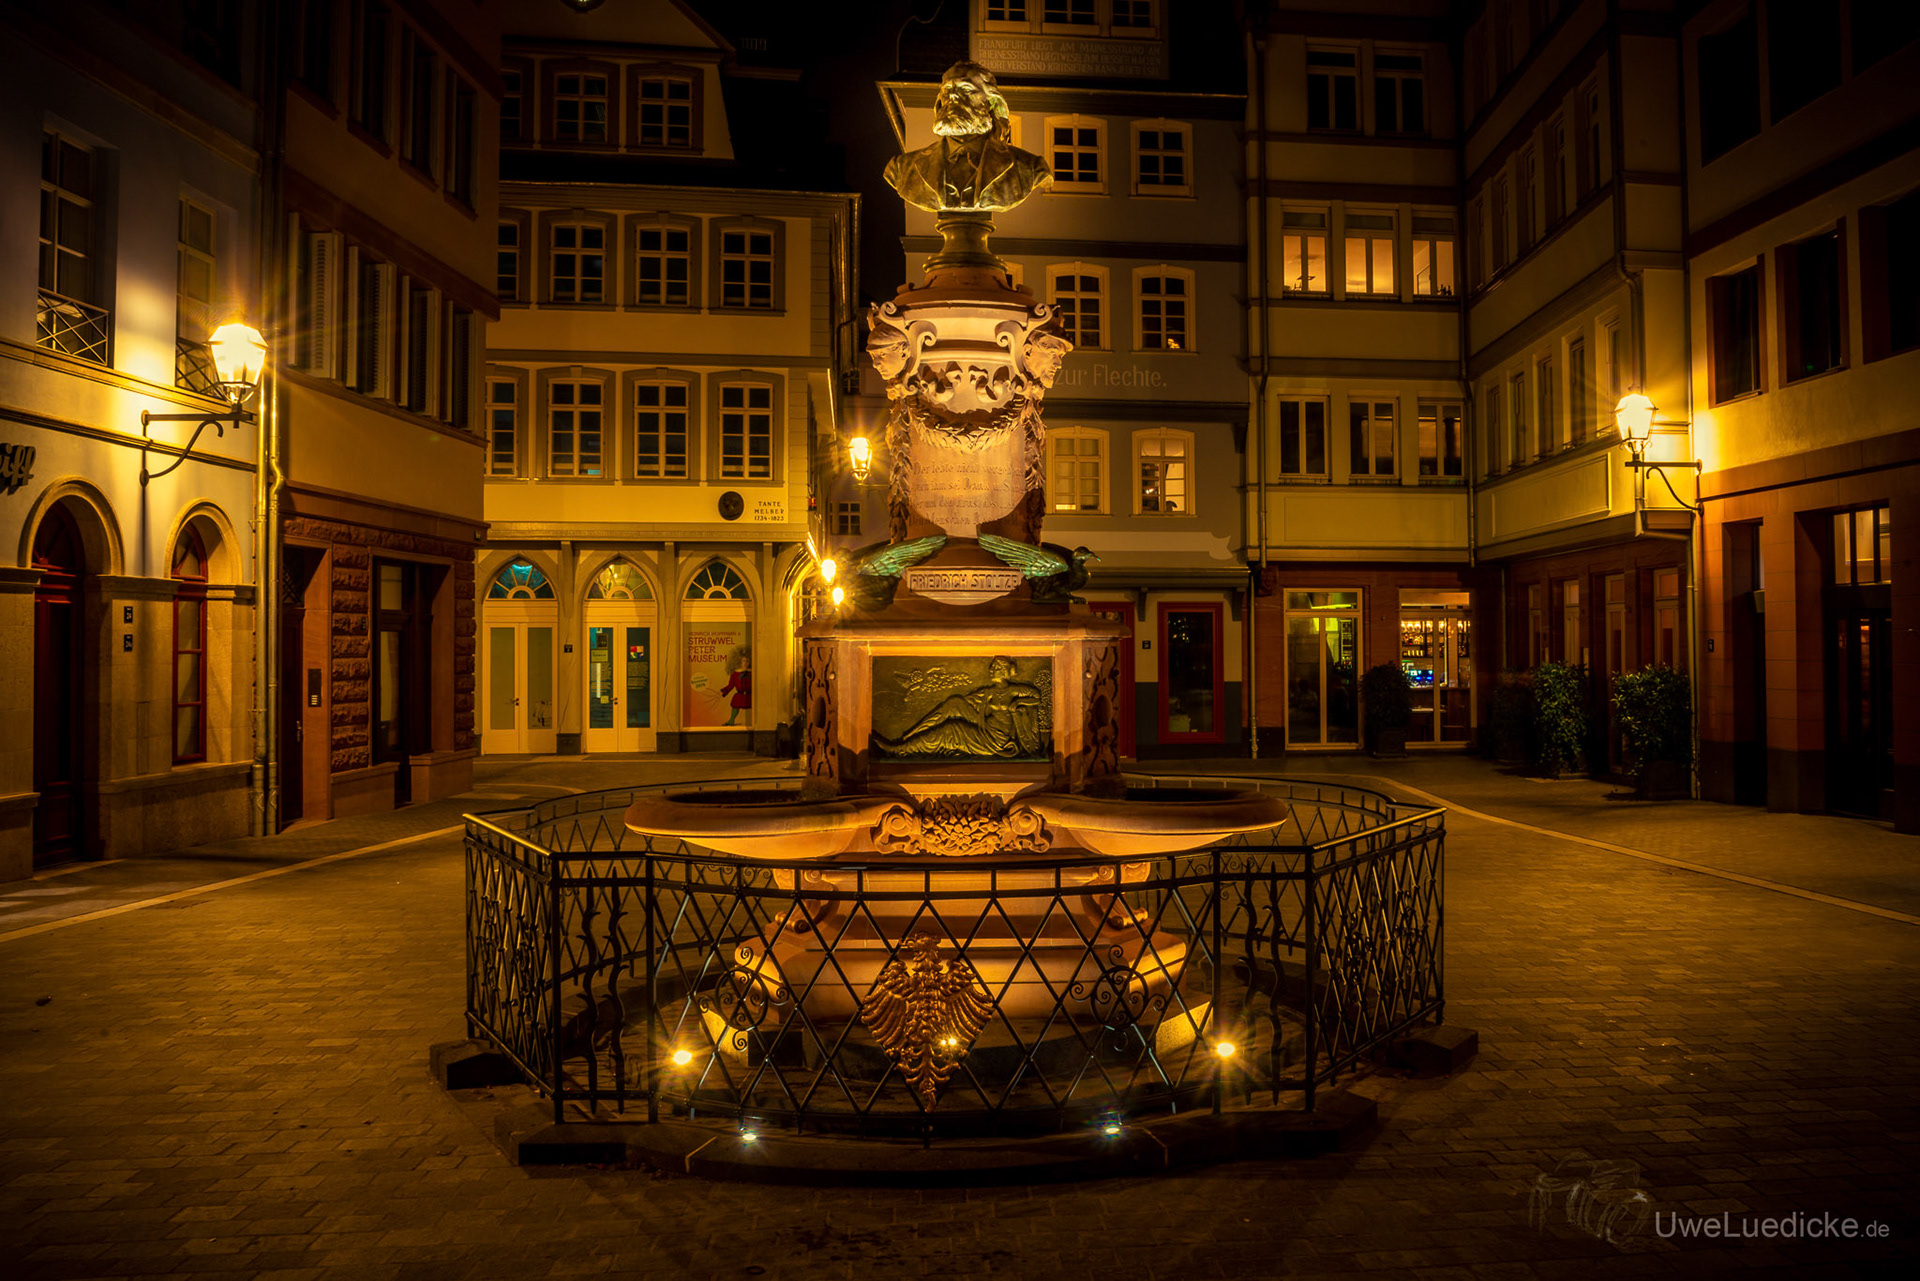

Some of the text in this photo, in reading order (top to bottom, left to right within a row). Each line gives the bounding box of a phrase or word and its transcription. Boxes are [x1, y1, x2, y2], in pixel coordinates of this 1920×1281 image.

[979, 39, 1027, 50] FRANKFURT
[1031, 41, 1053, 51] LIEGT
[1059, 42, 1075, 52] AM
[1093, 364, 1167, 387] Flechte.
[0, 442, 36, 487] iff
[911, 574, 967, 589] FRIEDRICH
[688, 637, 735, 645] STRUWWEL
[688, 646, 716, 654] PETER
[688, 654, 728, 663] MUSEUM
